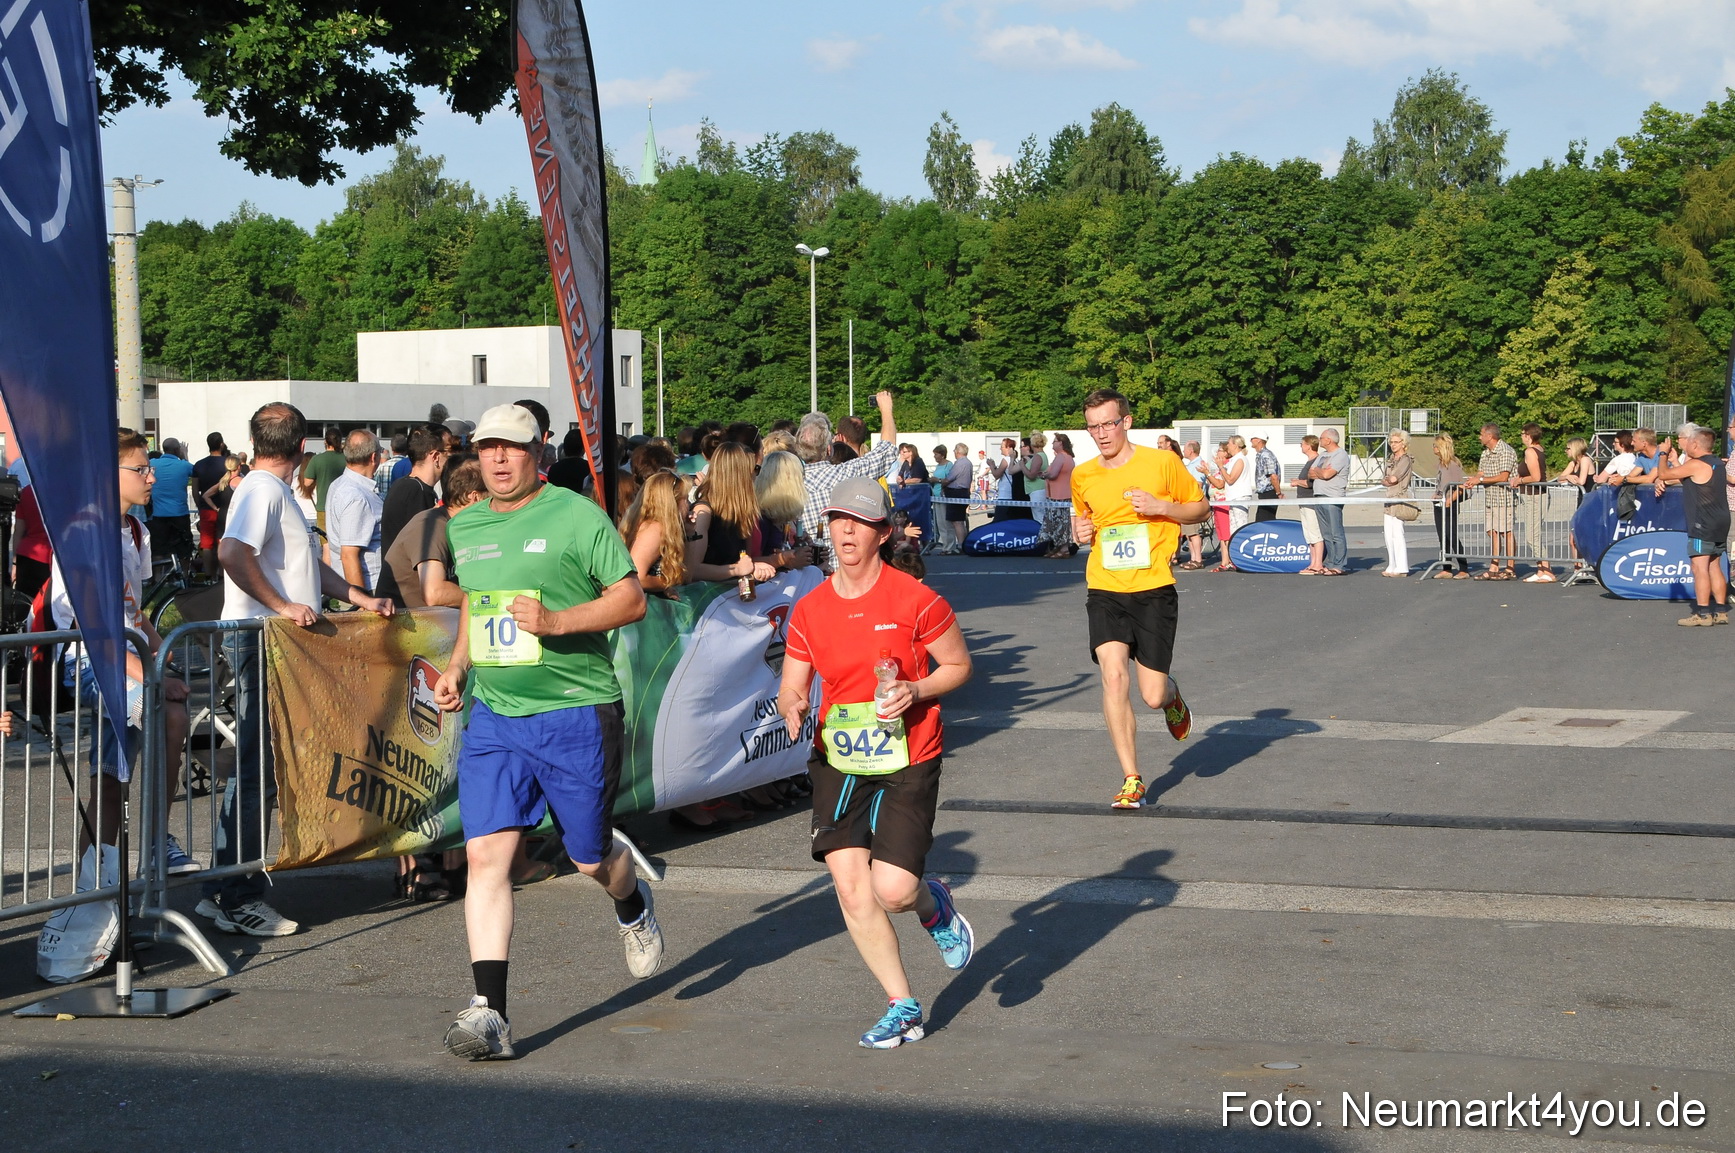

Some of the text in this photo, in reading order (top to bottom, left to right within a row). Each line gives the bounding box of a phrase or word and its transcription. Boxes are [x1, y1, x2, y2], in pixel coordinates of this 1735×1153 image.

[1112, 540, 1136, 559] 46
[1258, 554, 1310, 562] AUTOMOBILE
[1632, 560, 1691, 576] Fisch
[1640, 576, 1694, 585] AUTOMOB
[484, 616, 517, 647] 10
[416, 719, 435, 738] 1628
[833, 728, 894, 757] 942
[40, 931, 61, 945] ER
